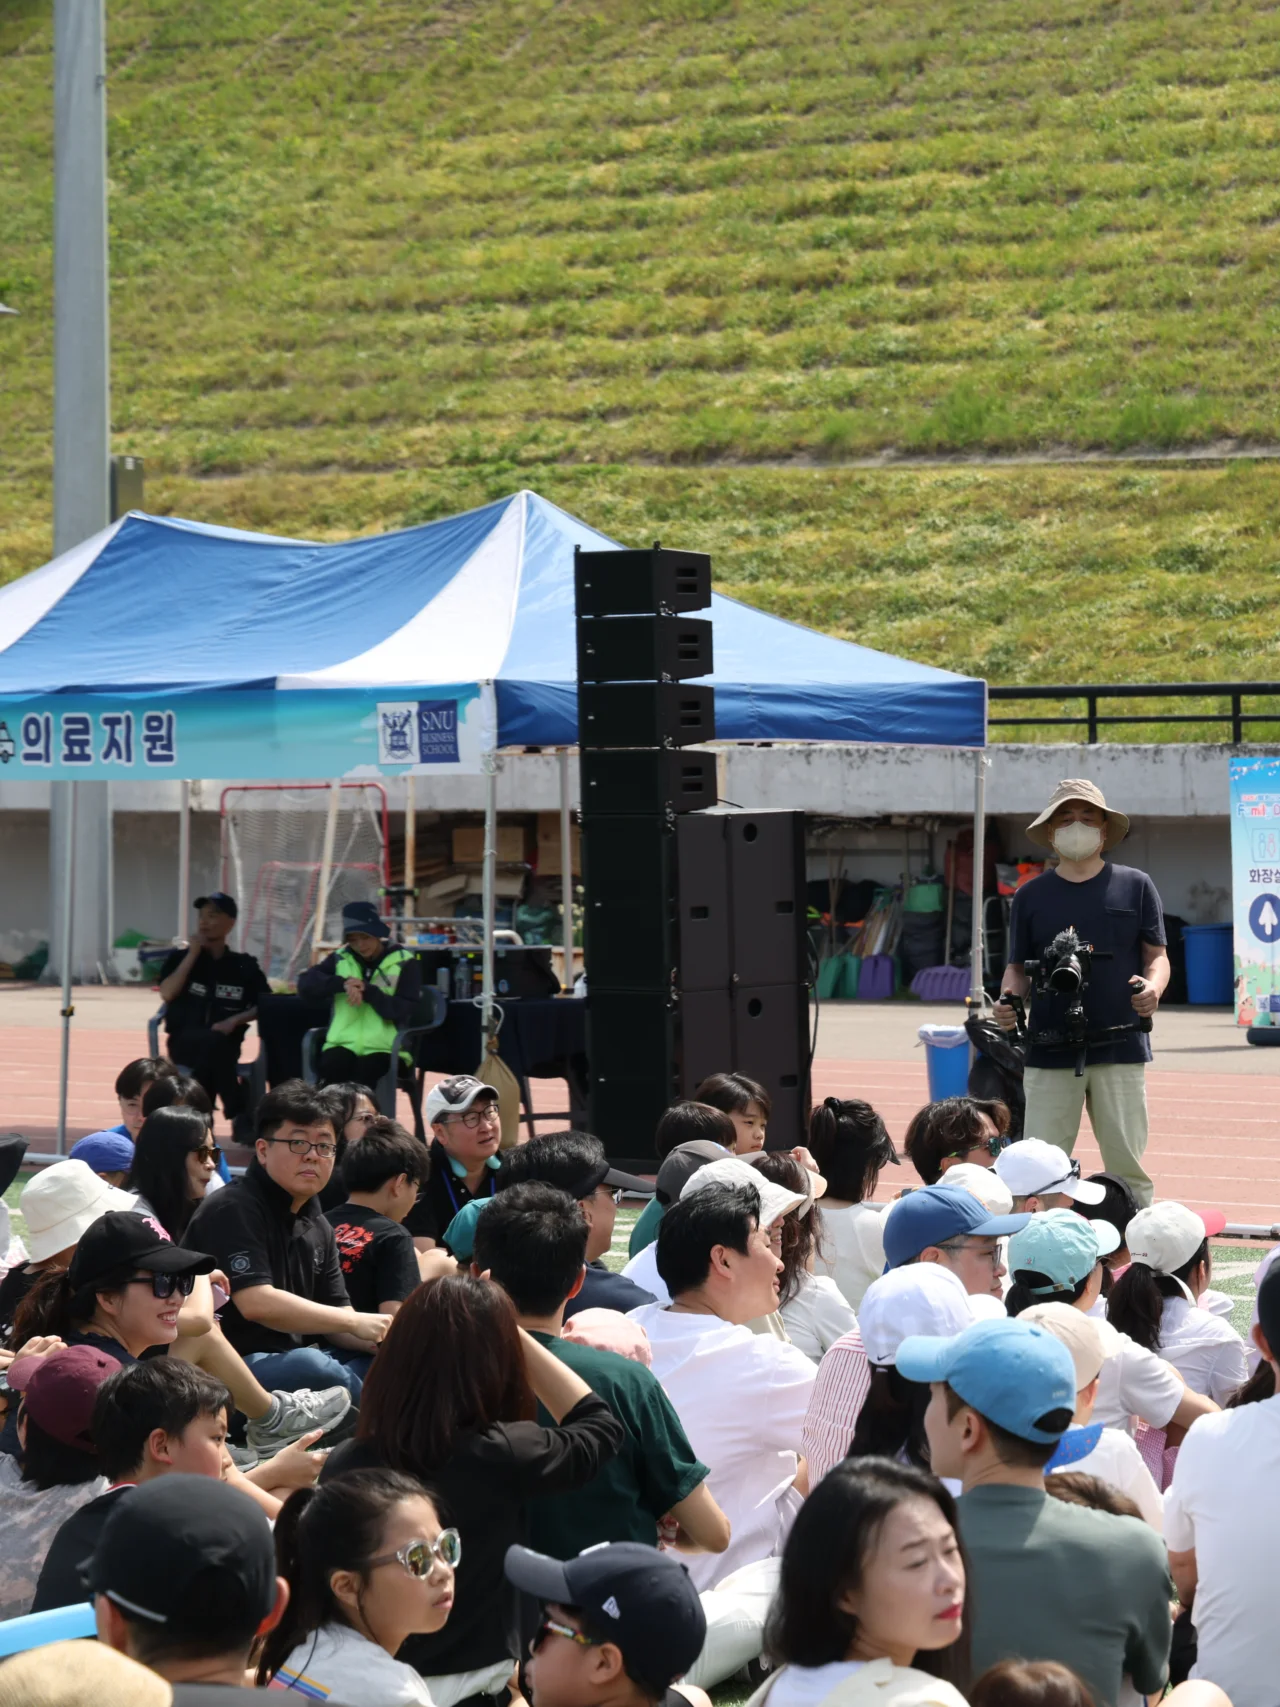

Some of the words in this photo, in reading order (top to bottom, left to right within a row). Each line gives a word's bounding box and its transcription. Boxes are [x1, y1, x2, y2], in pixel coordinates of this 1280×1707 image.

[421, 710, 454, 731] SNU
[21, 711, 175, 765] 의료지원
[422, 744, 456, 755] SCHOOL
[1237, 803, 1272, 820] Fmil
